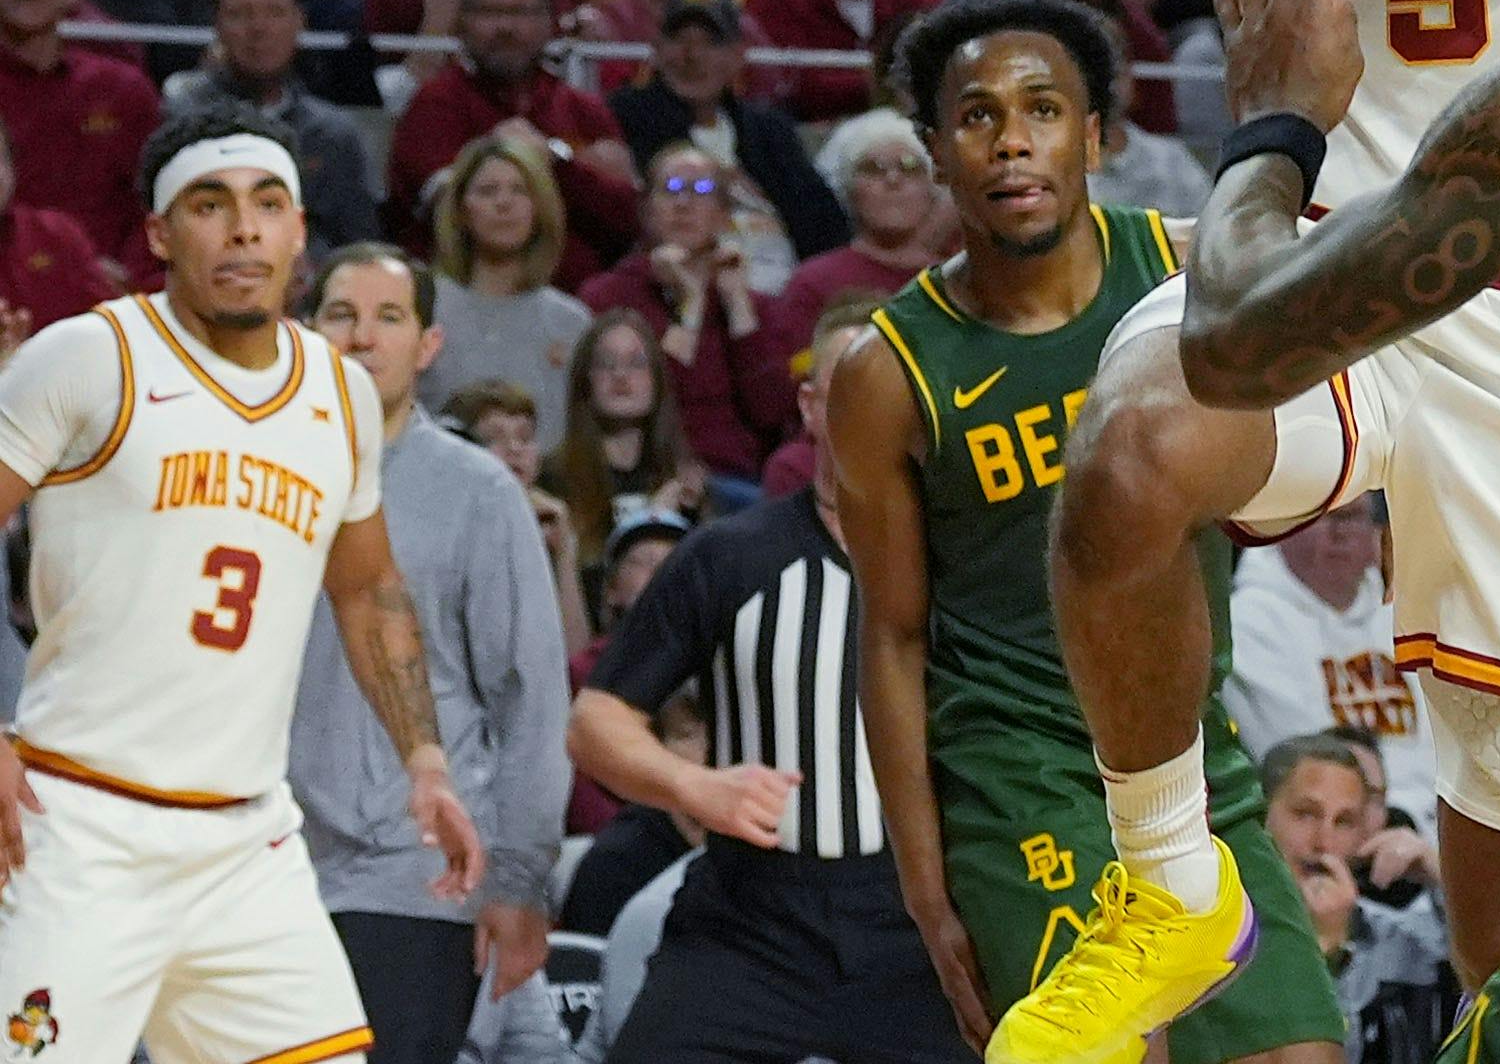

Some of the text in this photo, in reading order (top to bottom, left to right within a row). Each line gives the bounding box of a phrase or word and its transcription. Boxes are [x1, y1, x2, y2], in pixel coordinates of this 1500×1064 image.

[153, 452, 324, 544] IOWA STATE
[190, 545, 262, 651] 3
[1019, 830, 1077, 893] BU
